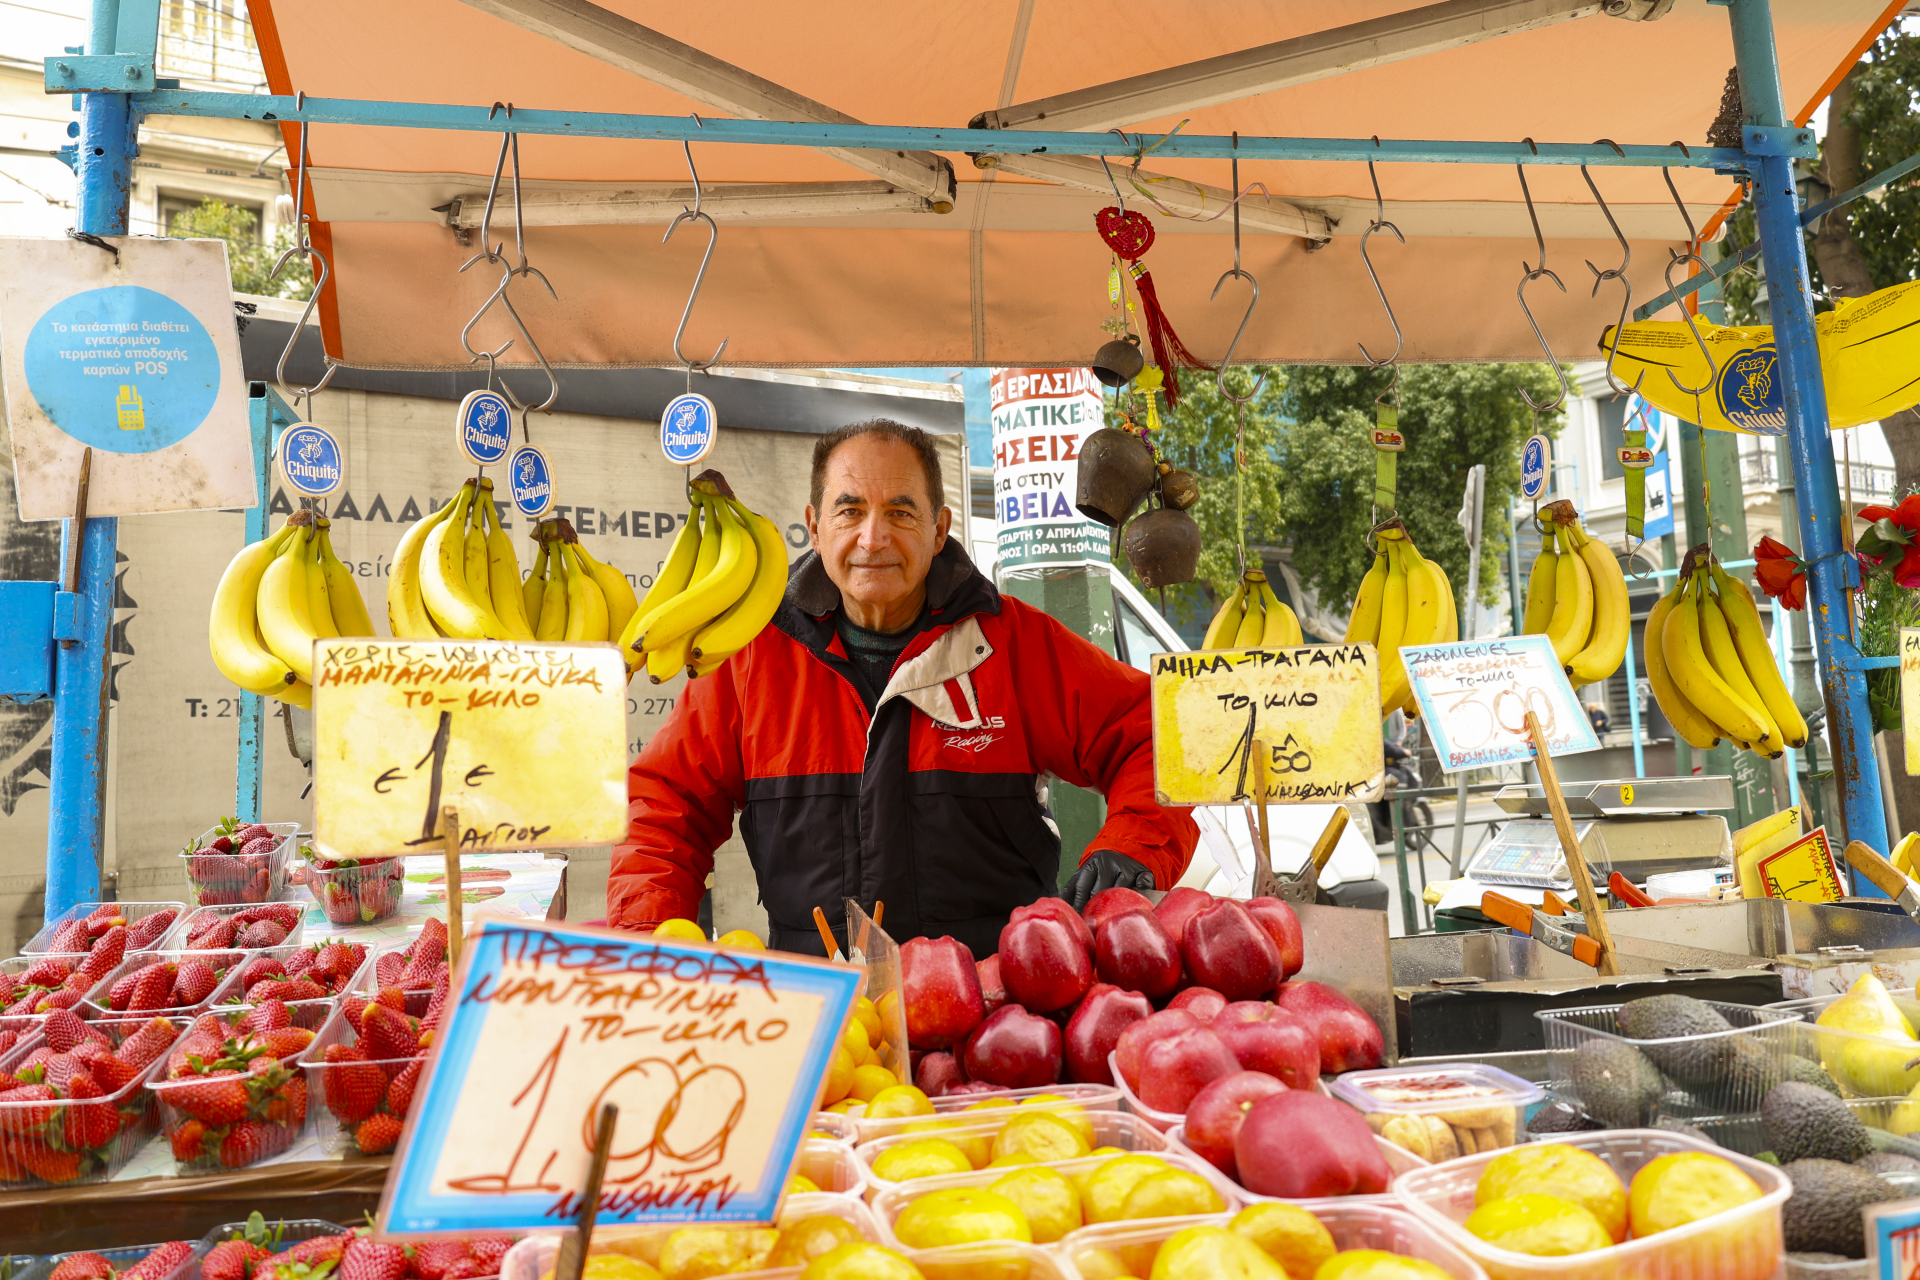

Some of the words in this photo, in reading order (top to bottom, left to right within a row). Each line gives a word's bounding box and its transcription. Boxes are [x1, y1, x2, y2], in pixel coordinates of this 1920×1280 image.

[51, 322, 67, 332] Το
[71, 321, 138, 333] κατάστημα
[142, 321, 189, 332] διαθέτει
[85, 334, 160, 347] εγκεκριμένο
[59, 348, 121, 361] τερματικό
[125, 347, 188, 361] αποδοχής
[83, 364, 130, 377] καρτών
[135, 361, 168, 375] POS
[1728, 407, 1786, 430] Chiqui
[465, 426, 508, 451] Chiquita
[665, 430, 707, 448] Chiquita
[286, 460, 339, 482] Chiquita
[1017, 472, 1065, 490] στην
[514, 482, 550, 503] Chiquita
[1031, 543, 1059, 555] ΩΡΑ
[1217, 693, 1250, 712] ΤΟ
[943, 731, 1004, 752] Racing
[403, 710, 452, 846] 1
[1623, 787, 1631, 801] 2
[467, 928, 778, 1002] ΠΡΟΣΦΟΡΑ
